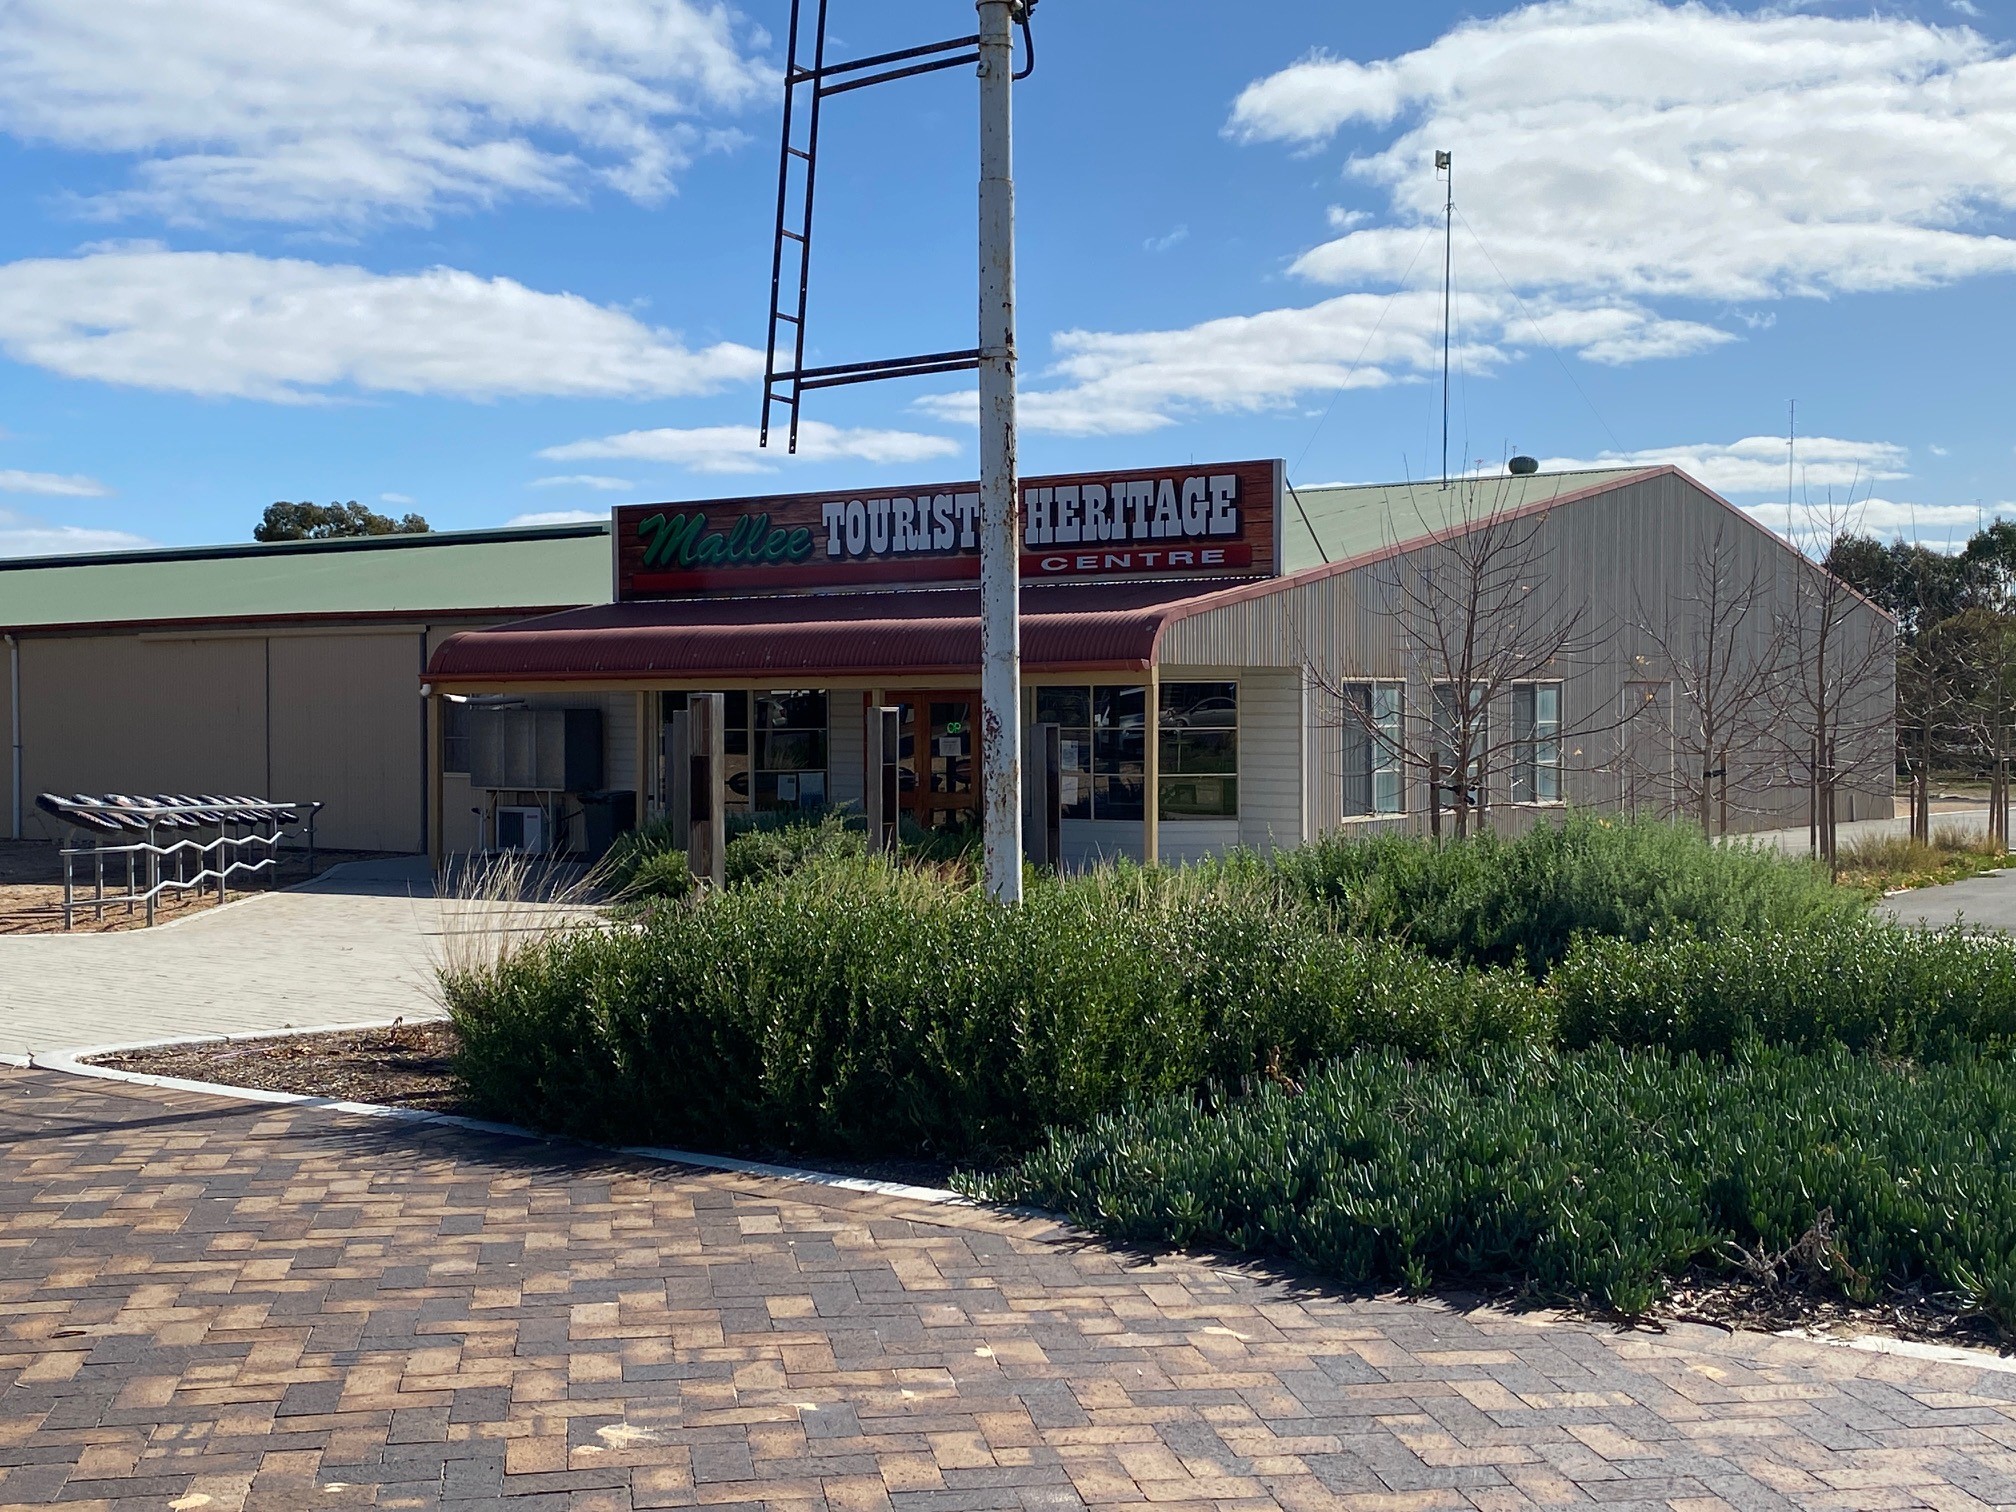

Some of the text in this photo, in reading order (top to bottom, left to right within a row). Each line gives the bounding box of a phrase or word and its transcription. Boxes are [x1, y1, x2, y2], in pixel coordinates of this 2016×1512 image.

[637, 474, 1237, 567] Mallee TOURIST HERITAGE
[1040, 549, 1226, 571] CENTRE
